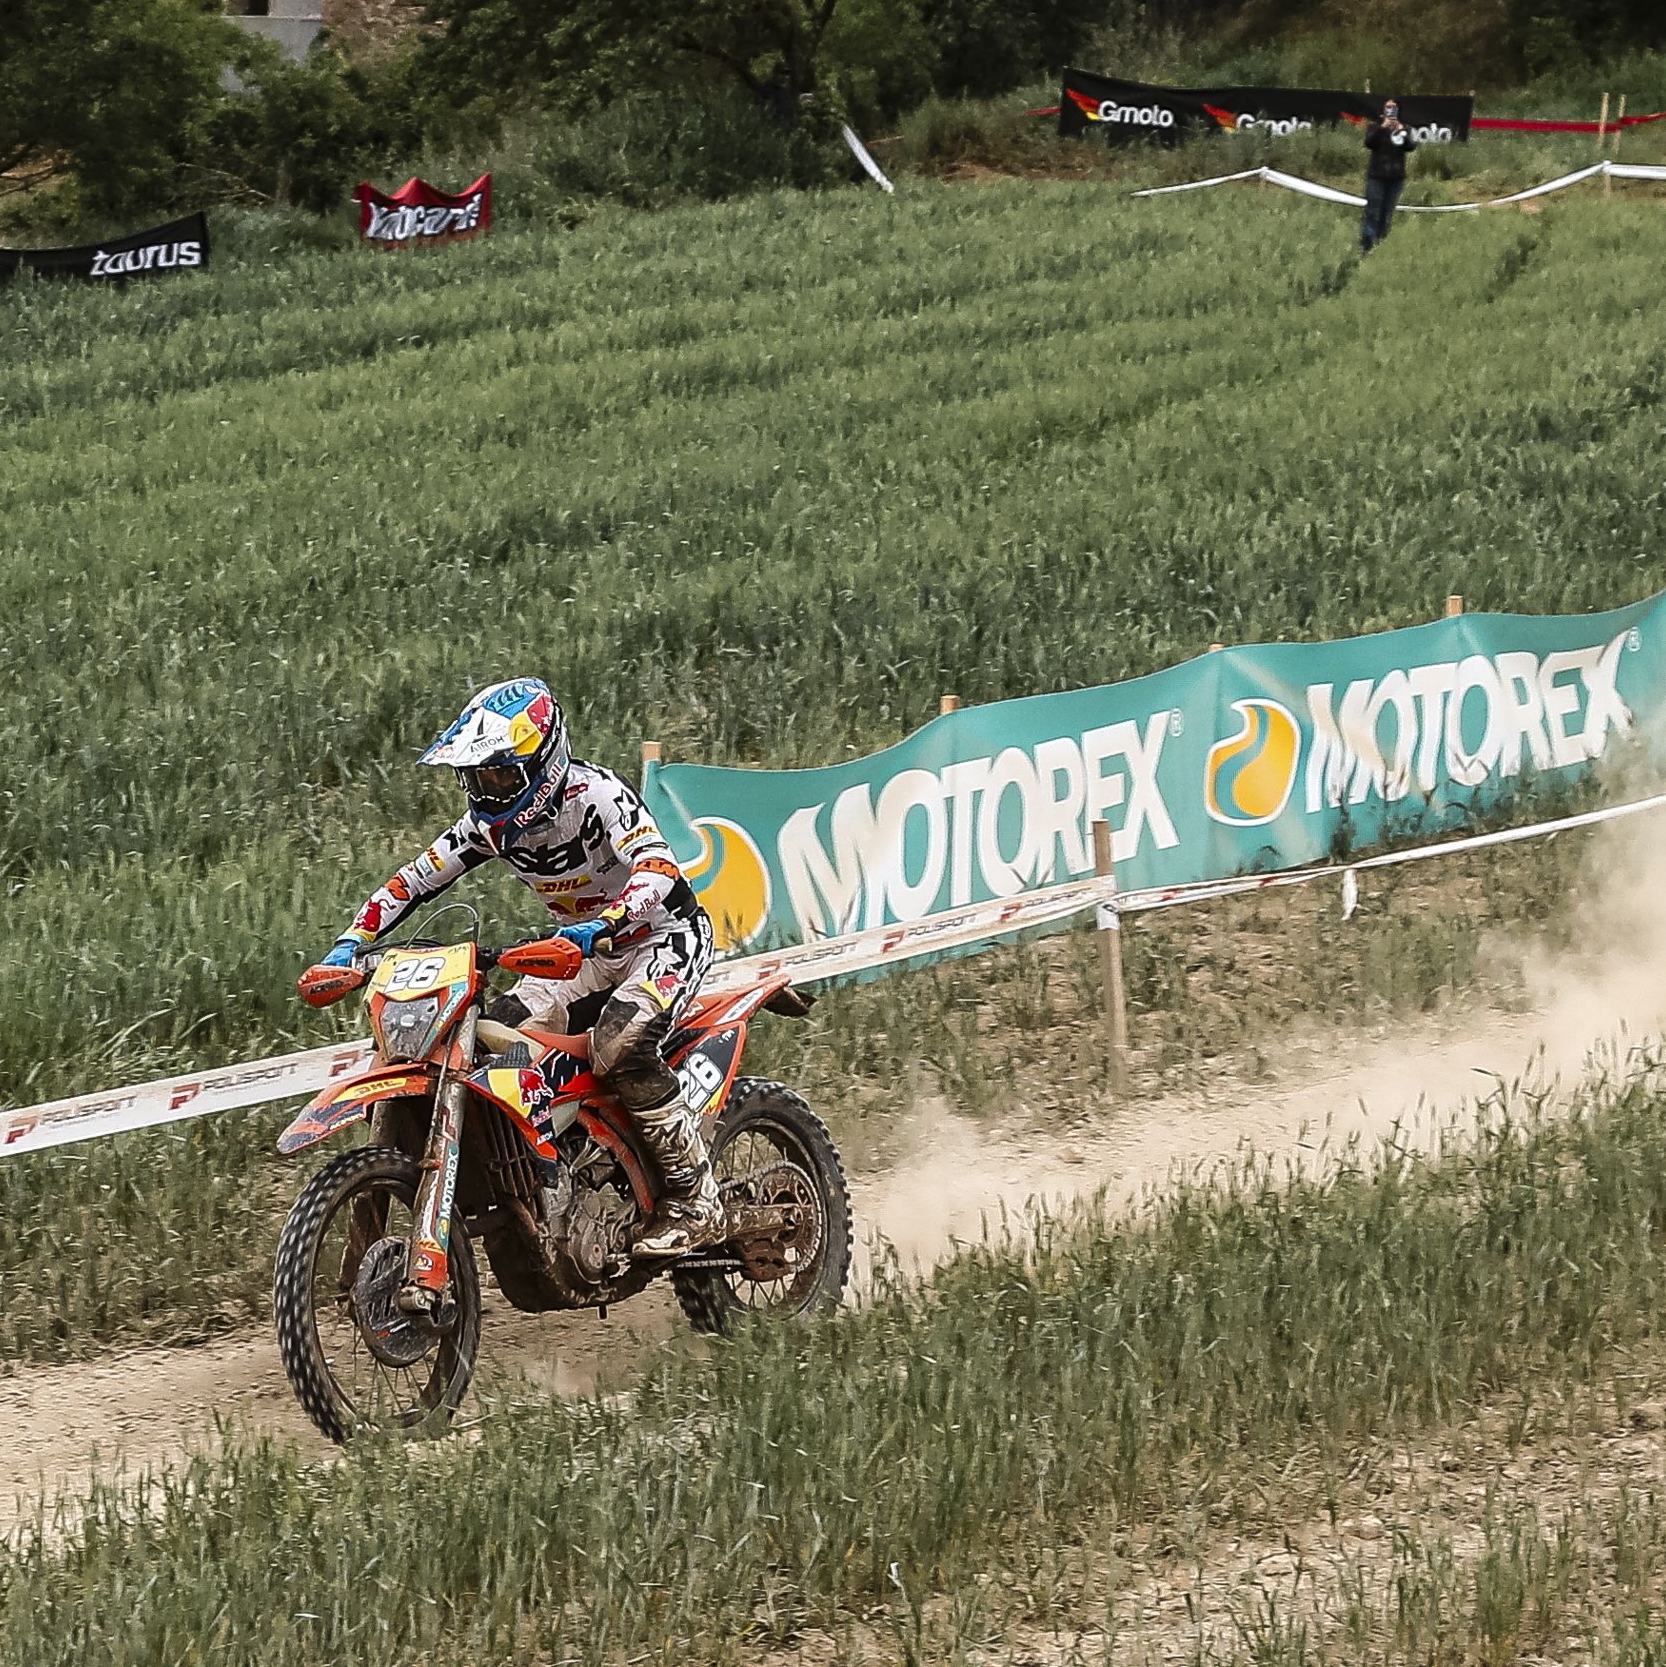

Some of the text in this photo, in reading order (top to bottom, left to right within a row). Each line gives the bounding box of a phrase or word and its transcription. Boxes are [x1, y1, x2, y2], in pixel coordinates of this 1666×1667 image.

[90, 240, 202, 277] taurus
[1304, 628, 1635, 814] MOTOREX
[777, 709, 1181, 942] MOTOREX
[383, 955, 447, 995] 26
[439, 1147, 459, 1219] MOTOREX
